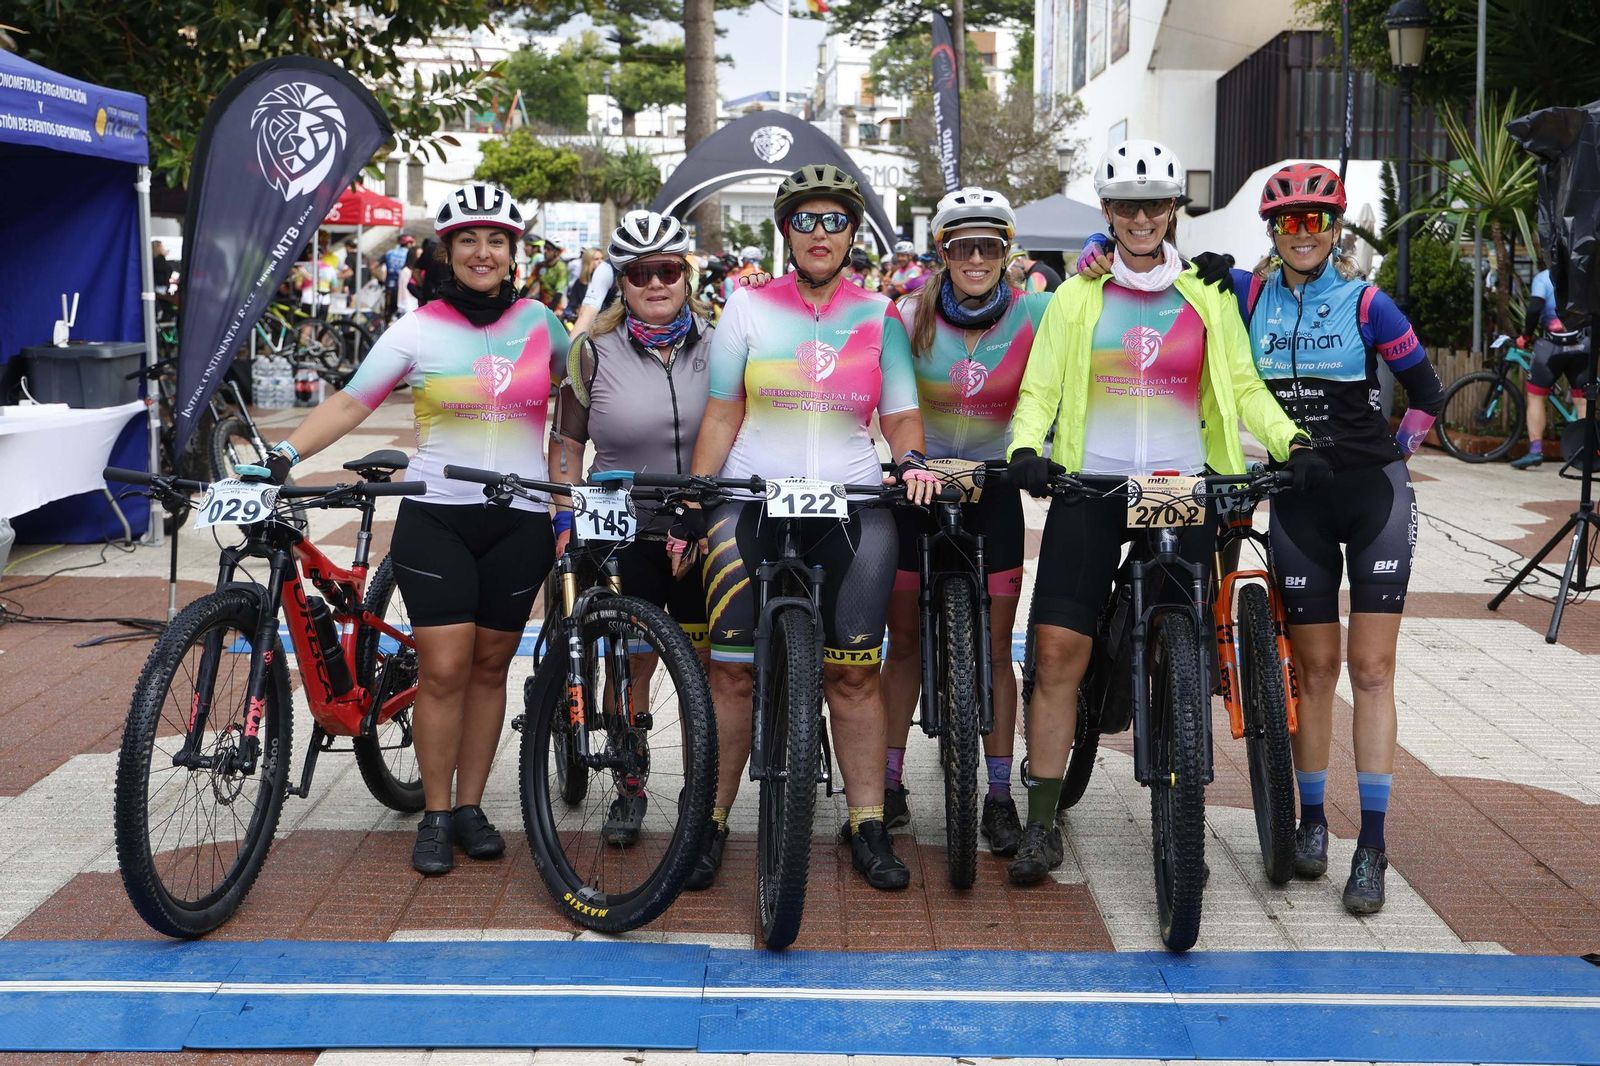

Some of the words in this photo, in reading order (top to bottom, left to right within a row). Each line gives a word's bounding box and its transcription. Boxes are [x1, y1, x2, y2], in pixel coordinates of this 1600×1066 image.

[38, 101, 43, 114] Y
[19, 117, 28, 132] DE
[28, 119, 55, 136] EVENTOS
[272, 226, 300, 259] MTB
[759, 387, 848, 401] INTERCONTINENTAL
[851, 392, 870, 401] RACE
[1129, 386, 1154, 397] MTB
[801, 401, 829, 412] MTB
[481, 412, 507, 422] MTB
[208, 498, 261, 523] 029
[782, 493, 836, 514] 122
[589, 508, 629, 537] 145
[1374, 560, 1398, 571] BH
[1285, 576, 1306, 586] BH
[568, 685, 585, 727] FOX
[244, 695, 265, 737] FOX
[563, 892, 609, 917] MAXXIS
